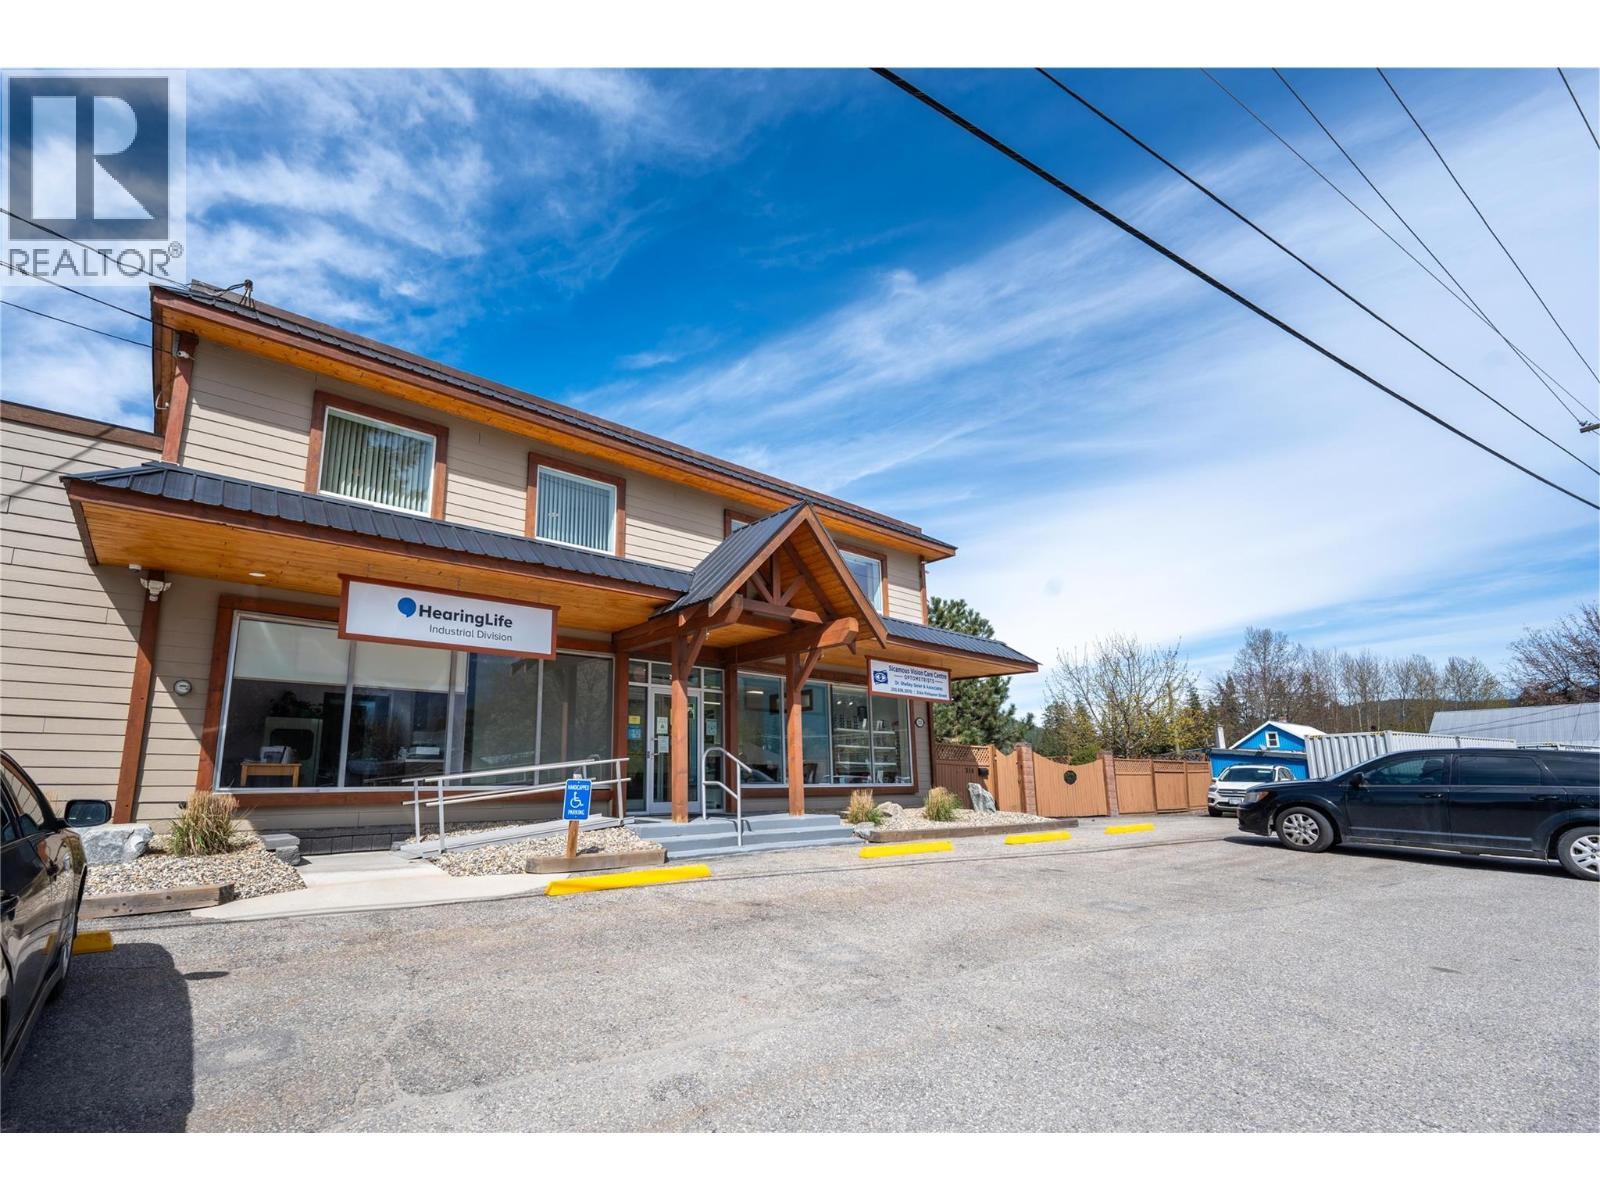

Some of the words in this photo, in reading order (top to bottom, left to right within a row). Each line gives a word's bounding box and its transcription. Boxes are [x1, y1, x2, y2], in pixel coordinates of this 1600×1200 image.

[419, 604, 513, 628] HearingLife
[429, 624, 475, 638] Industrial
[476, 629, 513, 642] Division
[888, 665, 910, 674] Sicamous
[910, 668, 924, 676] Vision
[924, 670, 934, 678] Care
